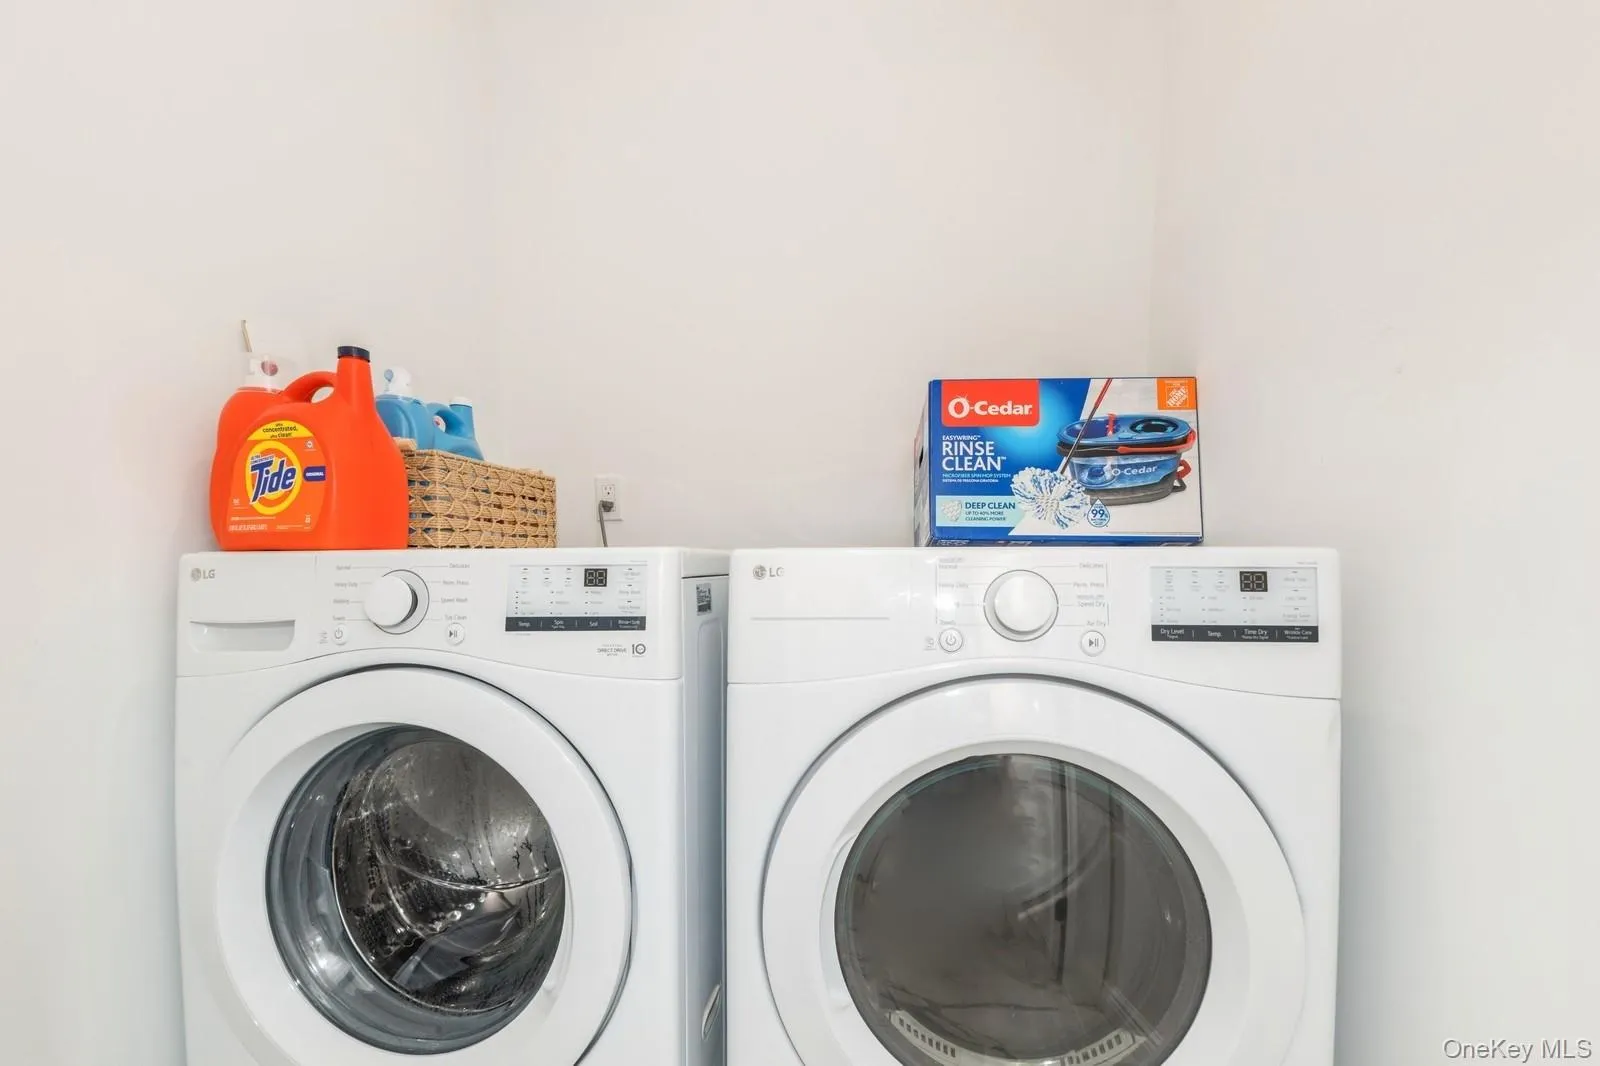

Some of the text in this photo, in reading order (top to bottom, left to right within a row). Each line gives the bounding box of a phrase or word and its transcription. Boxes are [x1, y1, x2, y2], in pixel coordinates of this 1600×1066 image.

[948, 396, 1032, 419] O-Cedar
[942, 441, 994, 456] RINSE
[1111, 466, 1157, 476] O-Cedar
[250, 459, 297, 503] Tide
[965, 502, 1016, 510] DEEP CLEAN
[203, 569, 216, 579] LG
[769, 566, 785, 577] LG
[1160, 628, 1171, 636] Dry
